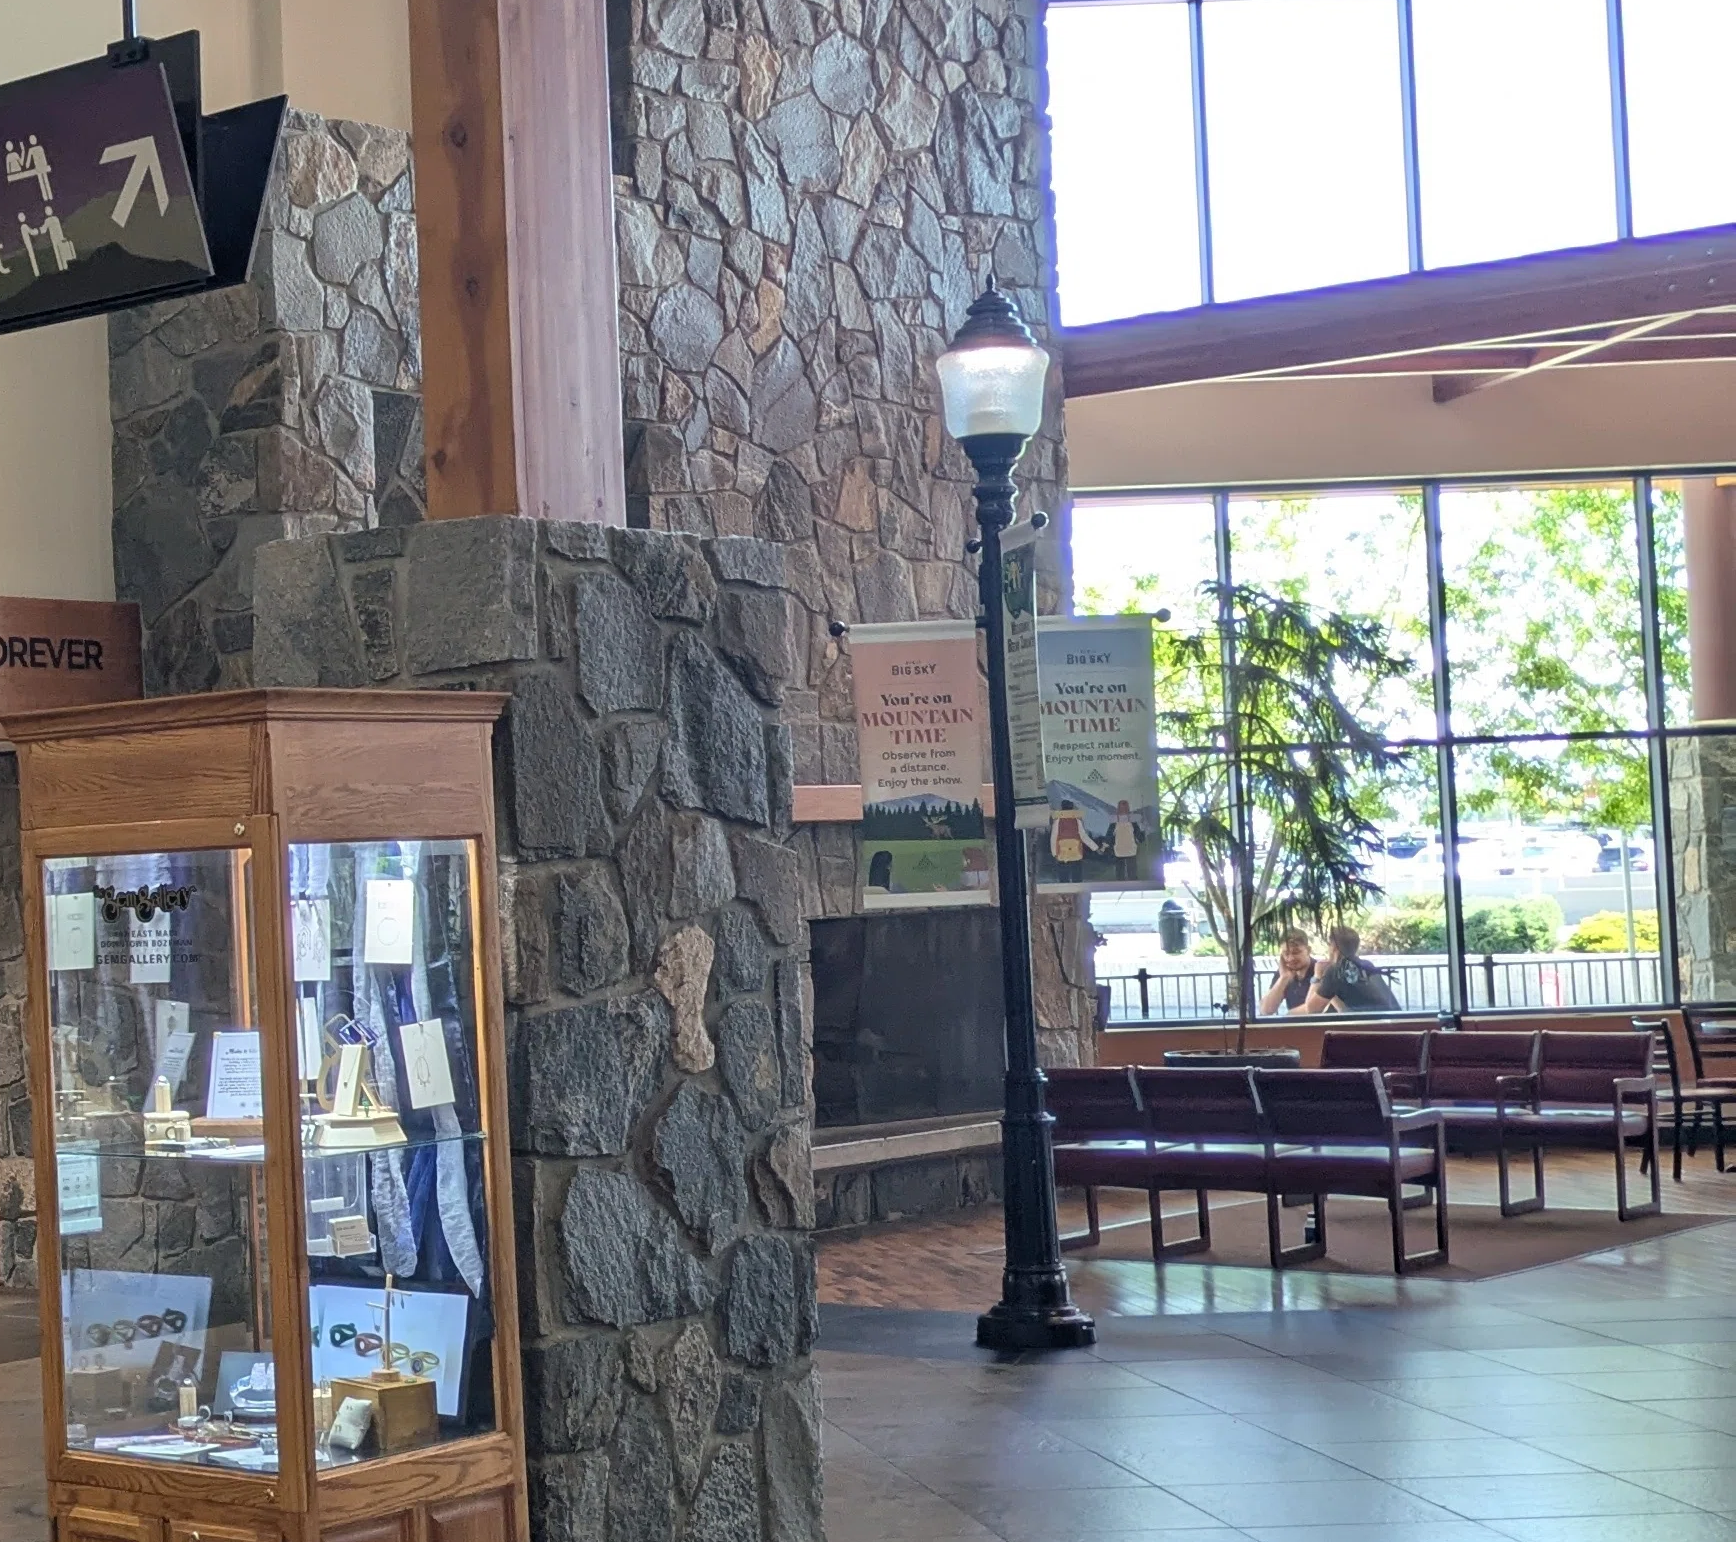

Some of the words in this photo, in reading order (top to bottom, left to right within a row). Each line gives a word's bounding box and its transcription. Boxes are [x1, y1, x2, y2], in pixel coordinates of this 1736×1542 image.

[1066, 653, 1087, 666] BIG
[1089, 651, 1111, 664] SKY
[891, 664, 912, 677] BIG
[914, 663, 937, 676] SKY
[1054, 681, 1104, 696] You're
[1107, 683, 1128, 694] on
[880, 692, 929, 707] You're
[932, 693, 953, 705] on
[1039, 697, 1150, 717] MOUNTAIN
[861, 707, 974, 729] MOUNTAIN
[1064, 716, 1122, 734] TIME
[889, 726, 948, 746] TIME
[1052, 742, 1095, 753] Respect
[1097, 740, 1133, 750] nature.
[882, 750, 927, 761] Observe
[930, 748, 957, 760] from
[1045, 754, 1075, 766] Enjoy
[1077, 753, 1095, 763] the
[890, 765, 897, 774] a
[900, 763, 950, 774] distance.
[877, 778, 907, 790] Enjoy
[910, 776, 929, 787] the
[131, 929, 153, 938] EAST
